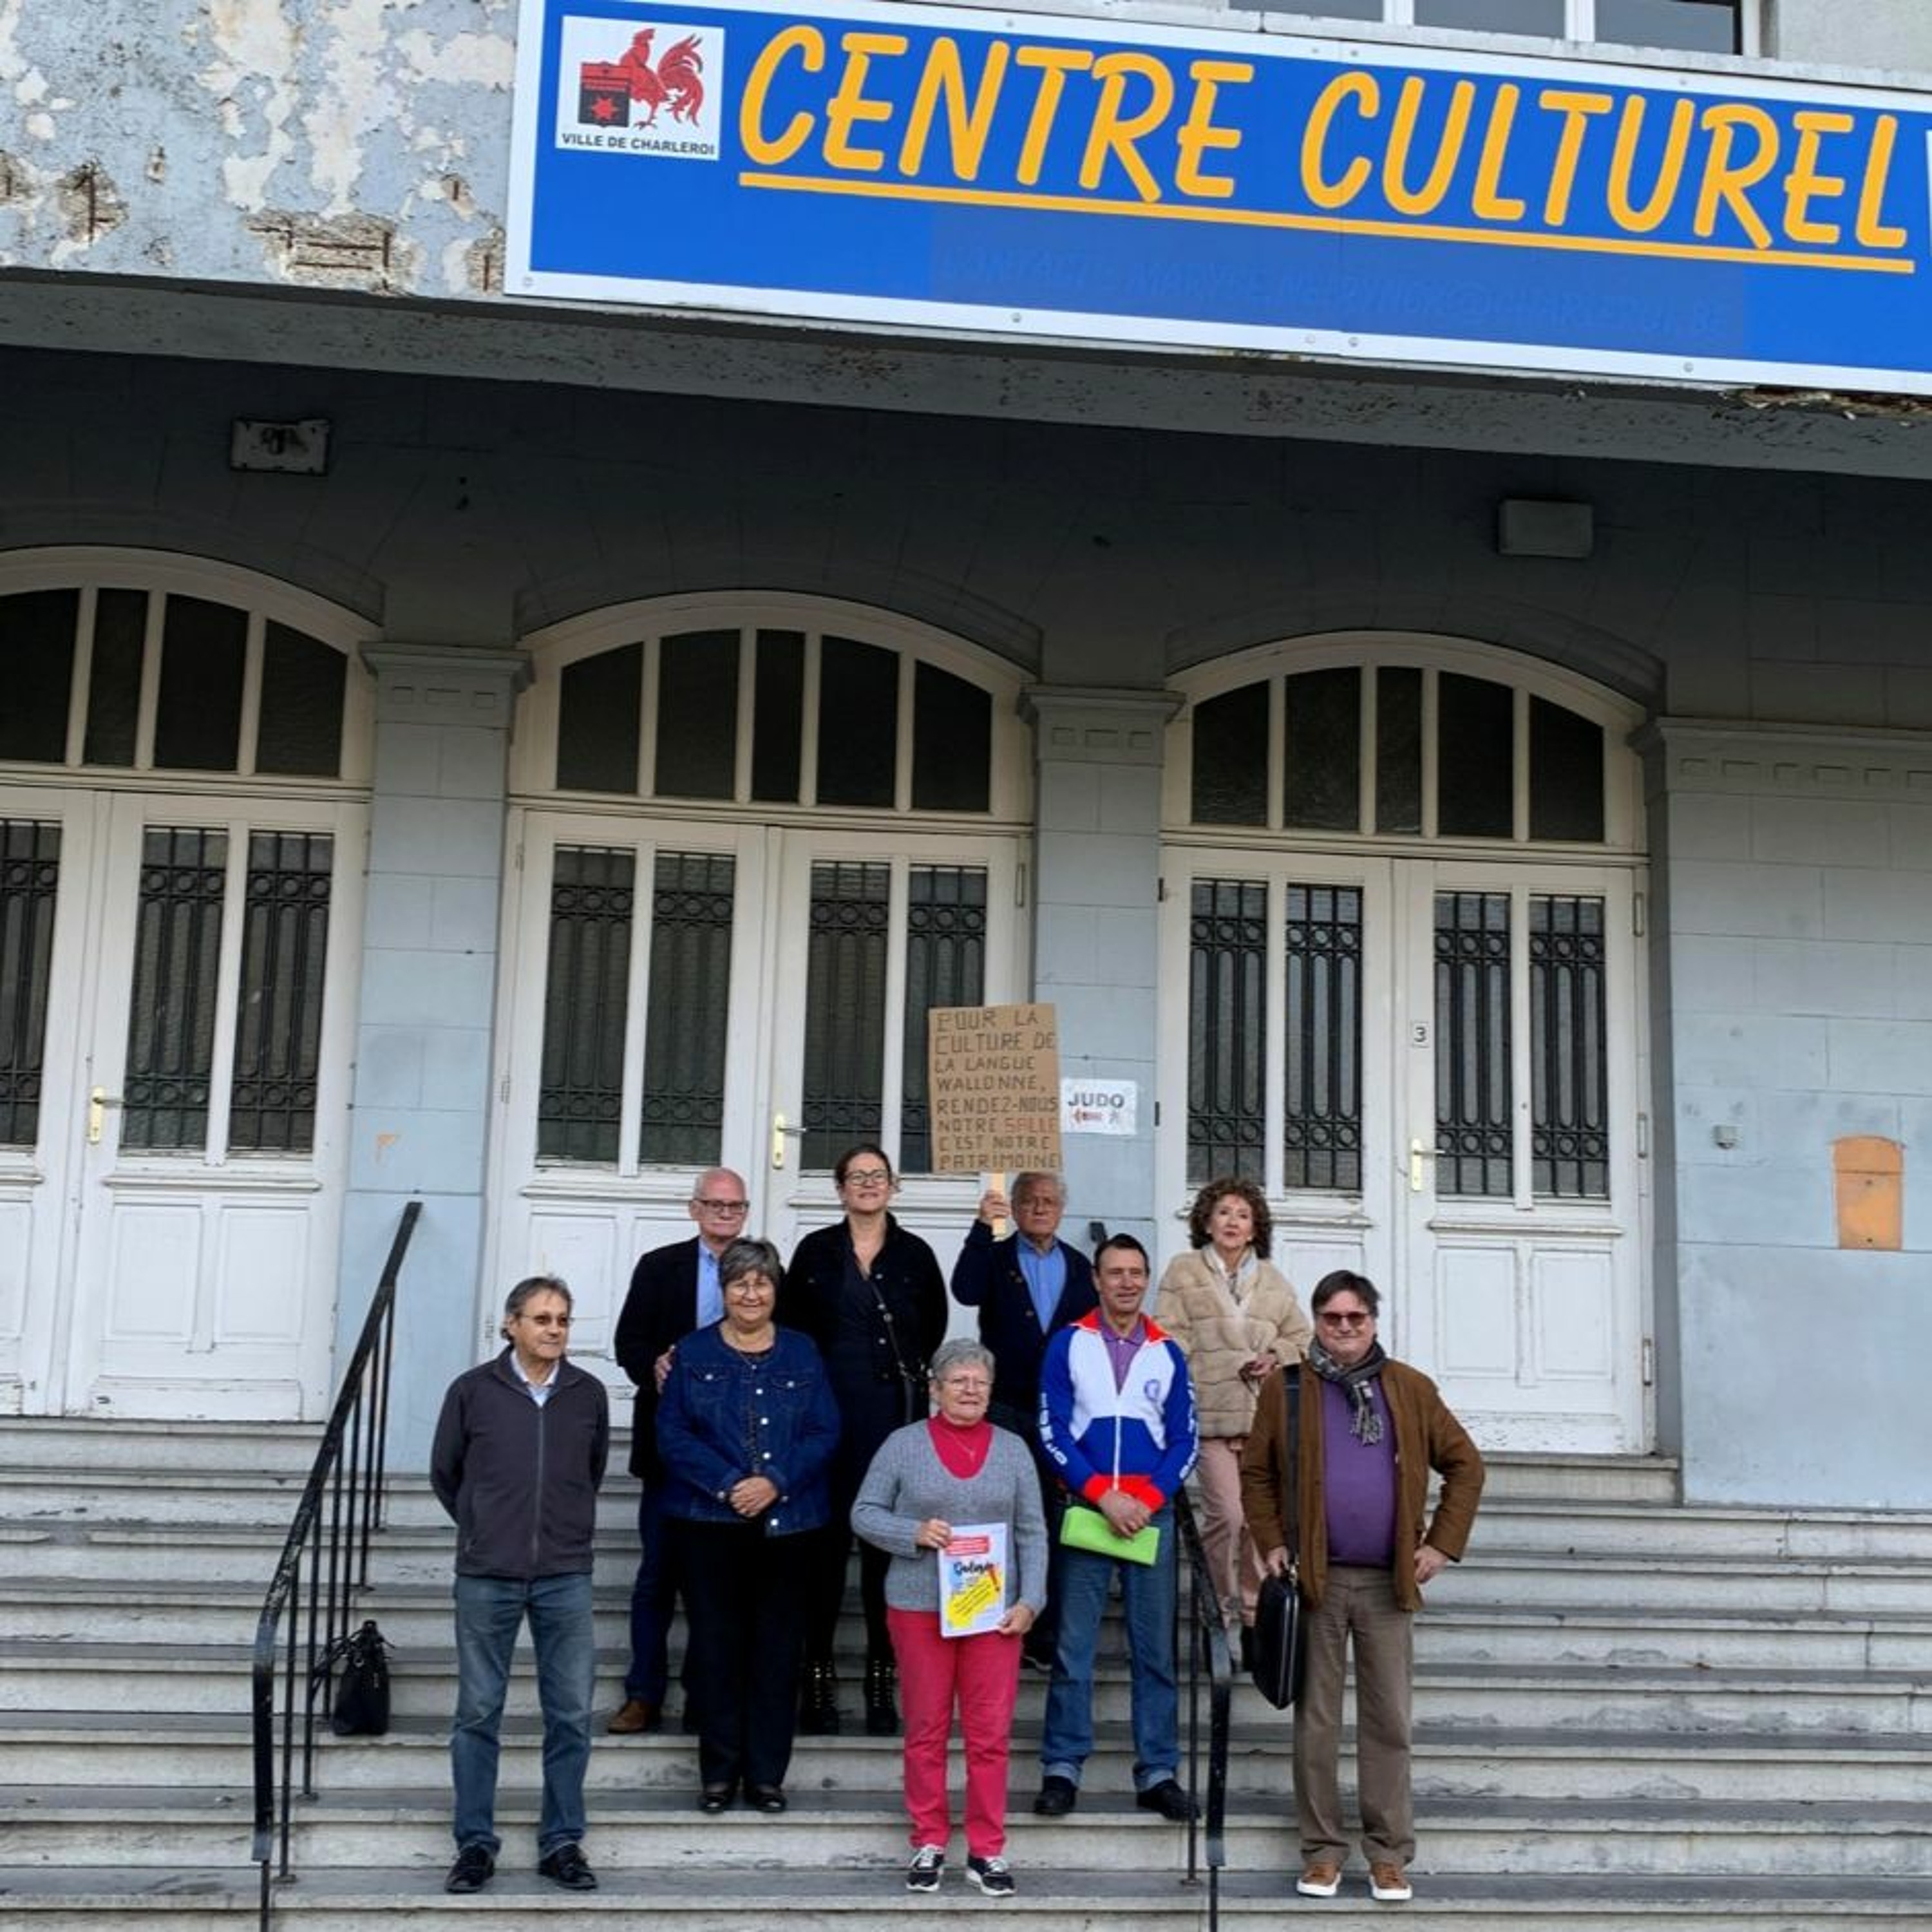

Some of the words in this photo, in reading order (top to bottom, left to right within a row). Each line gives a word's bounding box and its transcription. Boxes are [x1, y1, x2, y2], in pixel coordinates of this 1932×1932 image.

[562, 133, 603, 147] VILLE
[607, 137, 627, 149] DE
[630, 138, 715, 155] CHARLEROI
[739, 25, 1254, 203] CENTRE
[1300, 71, 1907, 249] CULTUREL
[936, 1010, 996, 1032] POUR
[1014, 1010, 1039, 1027] LA
[935, 1032, 1025, 1055] CULTURE
[1033, 1032, 1055, 1050] DE
[1414, 1026, 1426, 1043] 3
[934, 1057, 954, 1074] LA
[965, 1056, 1036, 1072] LANGUE
[936, 1097, 1059, 1115] RENDEZ-NOUS
[1068, 1093, 1124, 1108] JUDO
[937, 1118, 998, 1133] NOTRE
[1005, 1118, 1057, 1133] SALLE
[992, 1135, 1051, 1150] NOTRE
[939, 1153, 1060, 1170] PATRIMOINE
